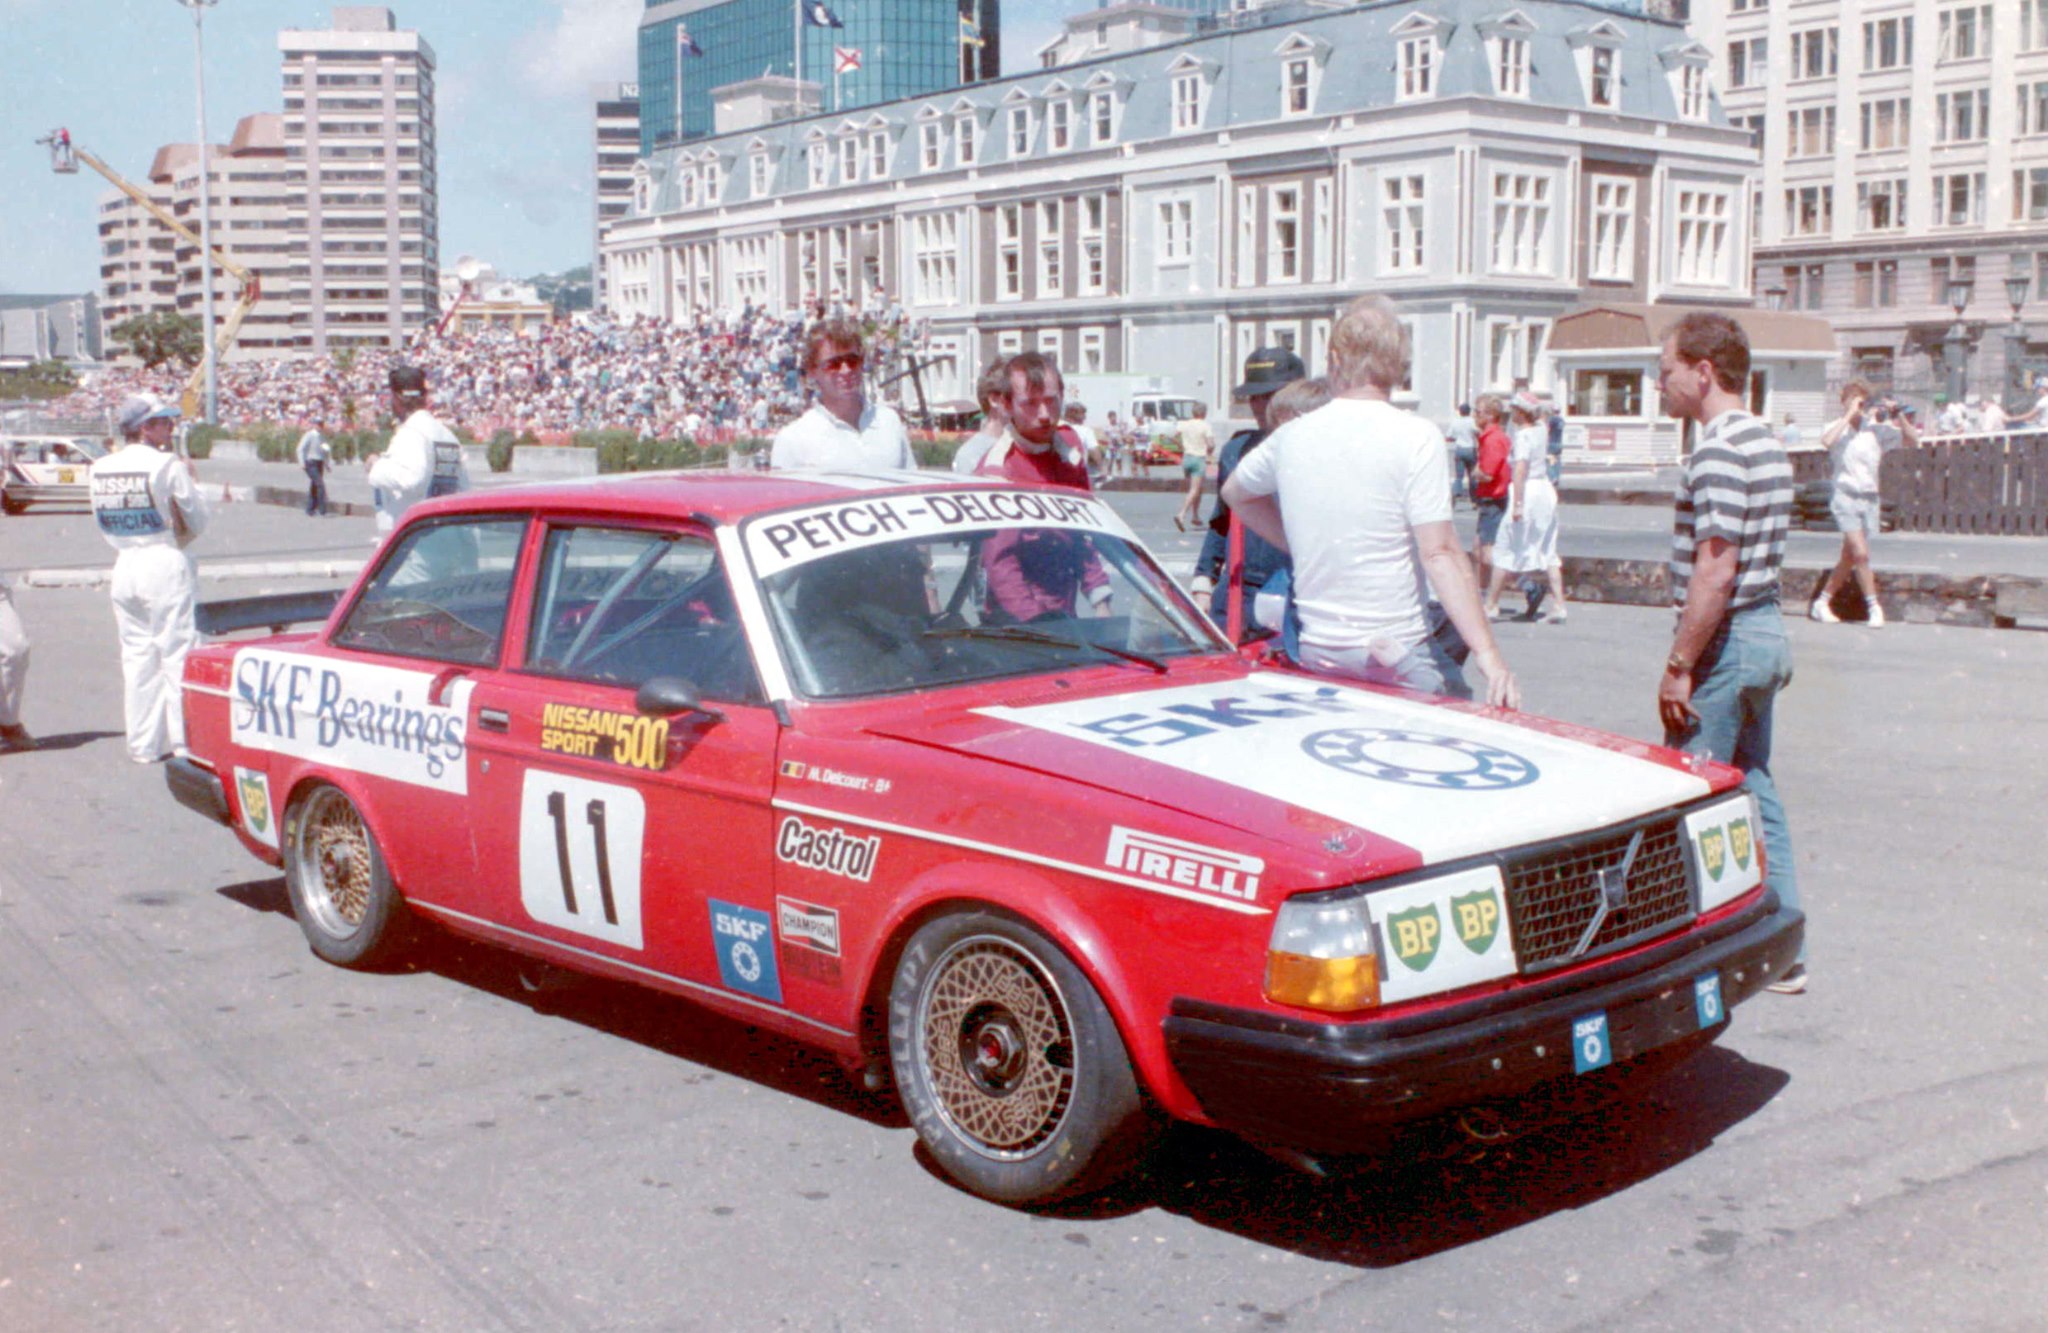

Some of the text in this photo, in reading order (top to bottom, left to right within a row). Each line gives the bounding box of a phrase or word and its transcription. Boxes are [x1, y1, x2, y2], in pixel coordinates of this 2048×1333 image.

[237, 656, 463, 779] SKF Bearings
[541, 729, 598, 757] SPORT
[542, 703, 669, 771] NISSAN 500
[243, 784, 265, 819] BP
[548, 791, 618, 926] 11
[778, 817, 879, 881] Castrol
[1703, 834, 1723, 869] BP
[1731, 826, 1749, 859] BP
[1105, 824, 1265, 901] PIRELLI
[716, 912, 767, 941] SKF
[783, 912, 834, 940] CHAMPION
[1396, 915, 1438, 958] BP
[1458, 899, 1497, 941] BP
[1575, 1016, 1606, 1038] SKF
